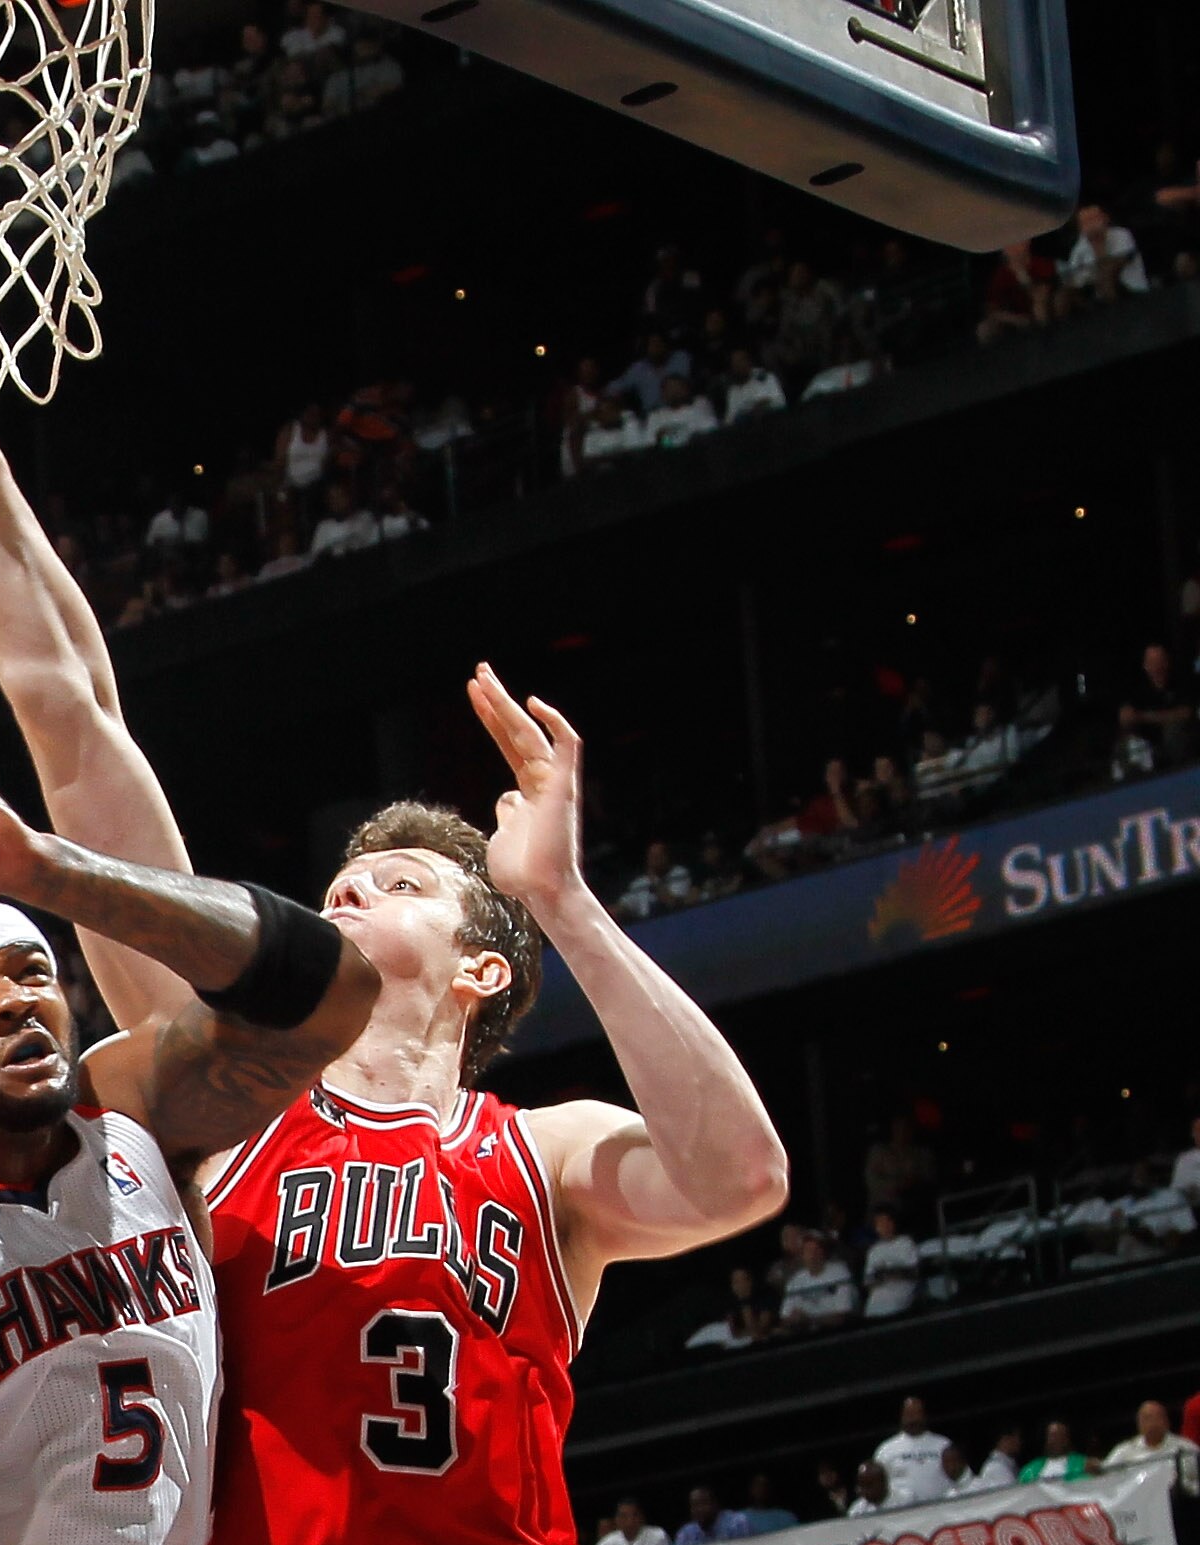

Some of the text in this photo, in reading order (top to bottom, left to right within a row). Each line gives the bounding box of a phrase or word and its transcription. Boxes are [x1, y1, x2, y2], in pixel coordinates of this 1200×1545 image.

[263, 1157, 523, 1338] BULLS
[92, 1357, 165, 1492] 5
[360, 1308, 460, 1477] 3
